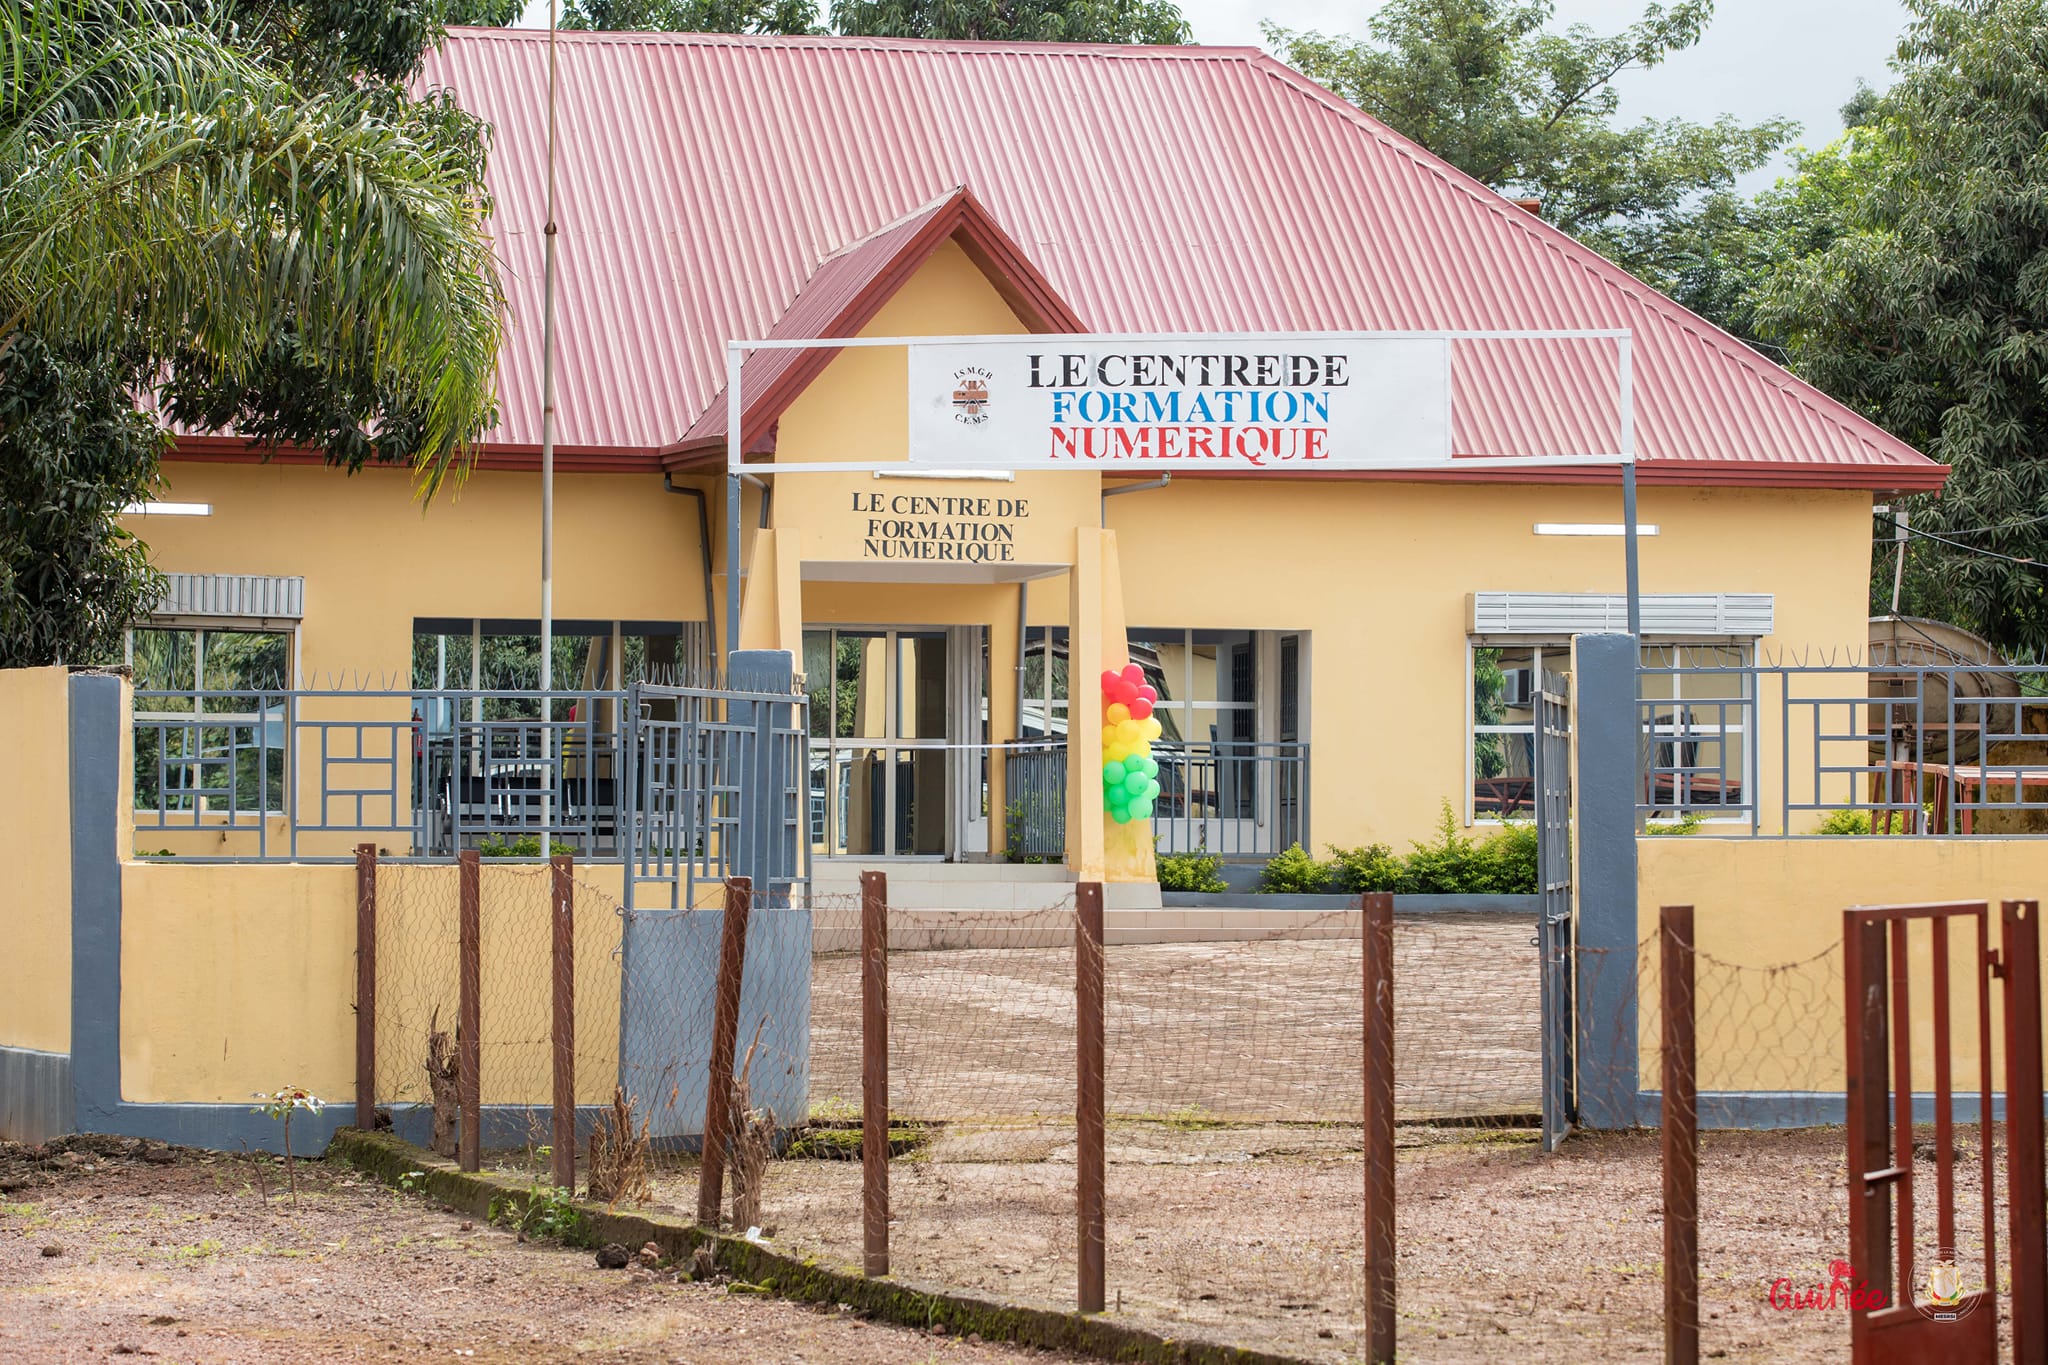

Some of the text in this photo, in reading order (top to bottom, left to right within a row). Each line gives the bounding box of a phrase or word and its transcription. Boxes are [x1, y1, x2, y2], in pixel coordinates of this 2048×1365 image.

[1026, 354, 1350, 388] LE CENTRE DE
[1050, 390, 1330, 423] FORMATION
[1049, 426, 1330, 466] NUMERIQUE
[852, 492, 1030, 518] LE CENTRE DE
[867, 519, 1014, 542] FORMATION
[863, 539, 1015, 564] NUMERIQUE
